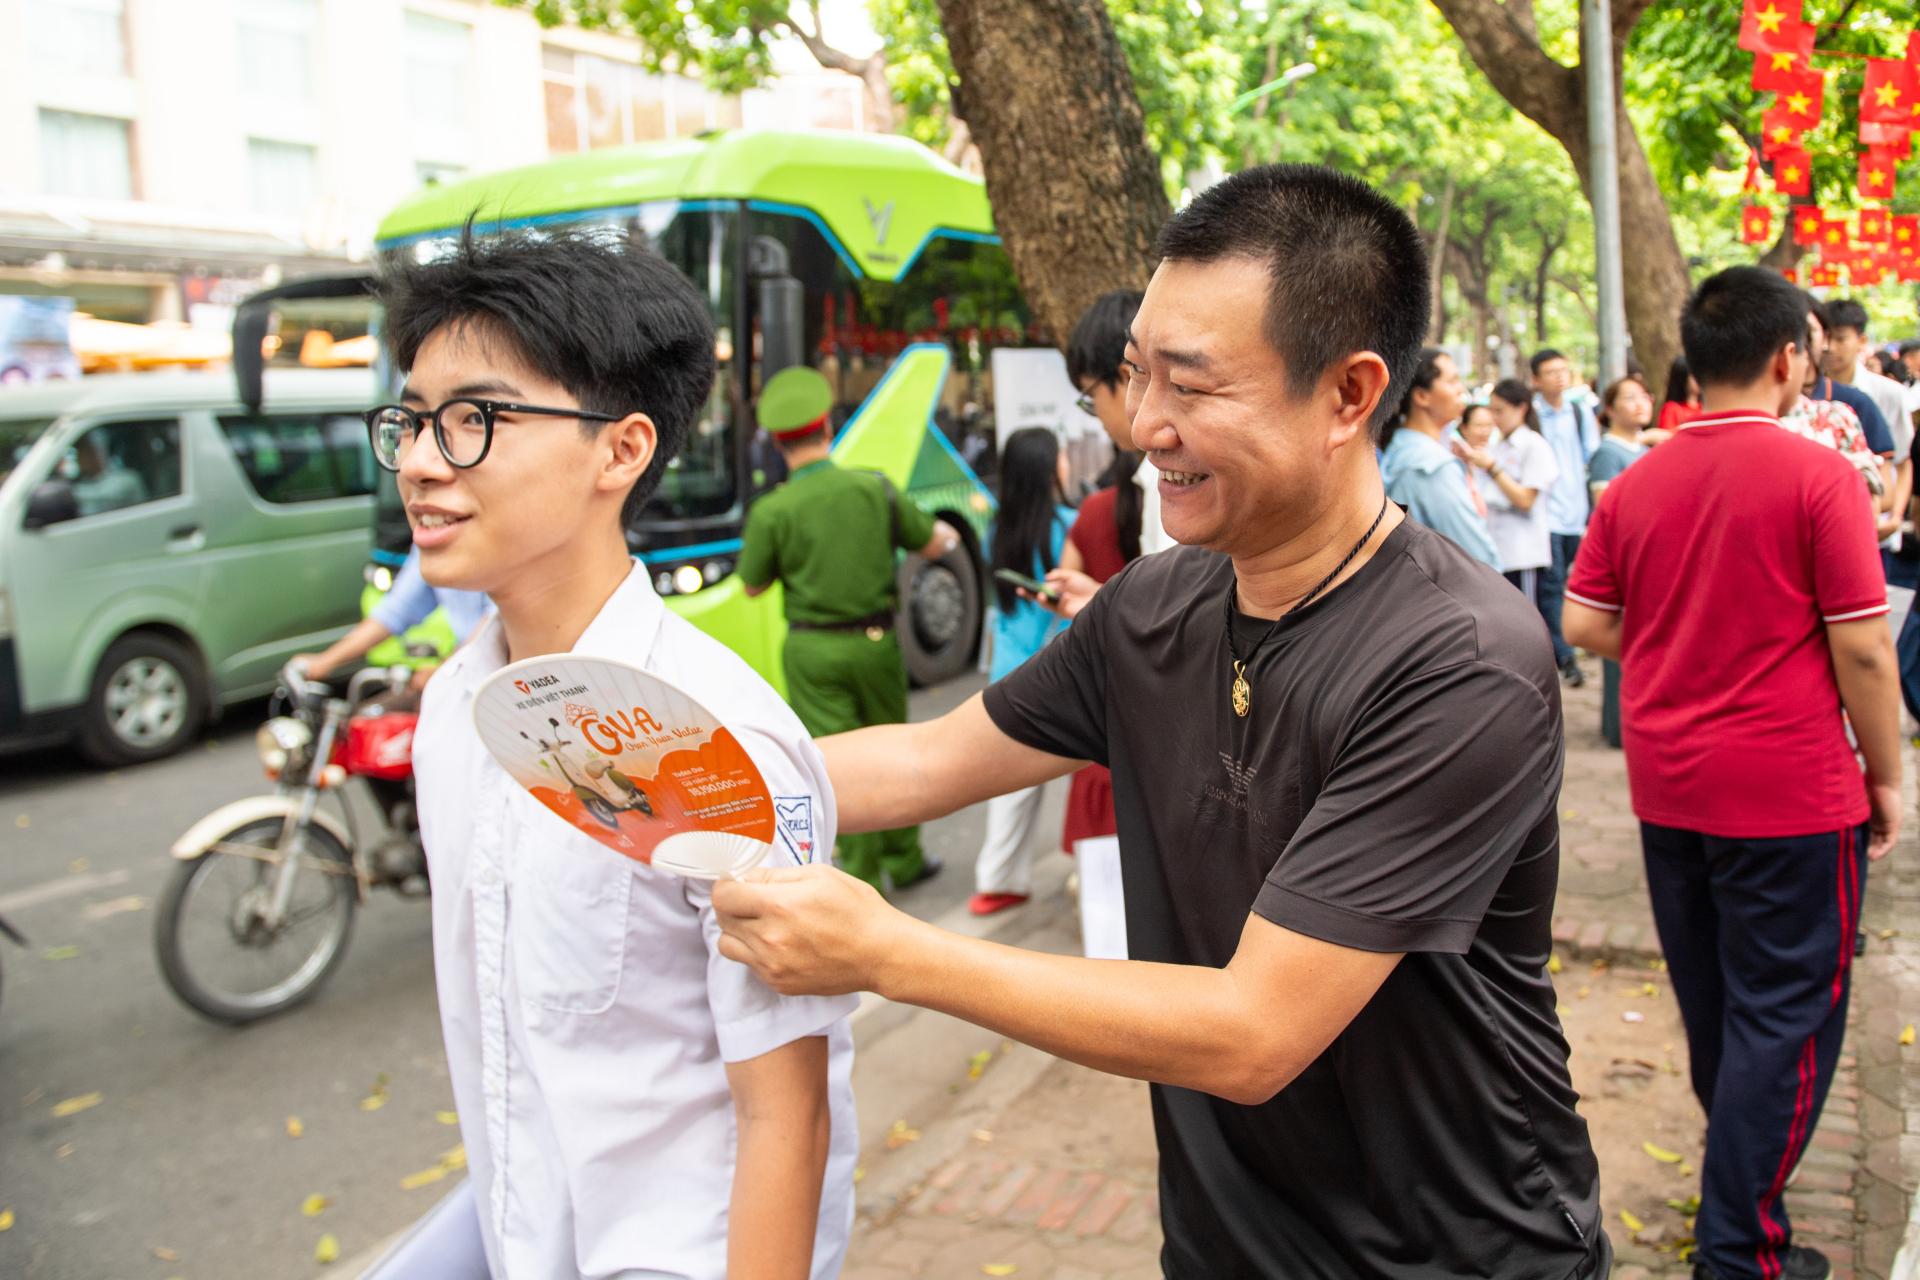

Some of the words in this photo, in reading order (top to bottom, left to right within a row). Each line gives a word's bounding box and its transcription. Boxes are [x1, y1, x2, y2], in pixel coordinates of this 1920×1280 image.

[527, 675, 561, 689] YADEA
[515, 702, 527, 710] XE
[543, 692, 561, 703] VIỆT
[559, 685, 589, 698] THANH
[581, 707, 662, 755] OVA
[625, 741, 649, 751] Own
[646, 734, 674, 747] Your
[671, 726, 703, 738] Value
[672, 769, 692, 778] Yadea
[690, 766, 705, 774] Ova
[681, 779, 694, 787] Giá
